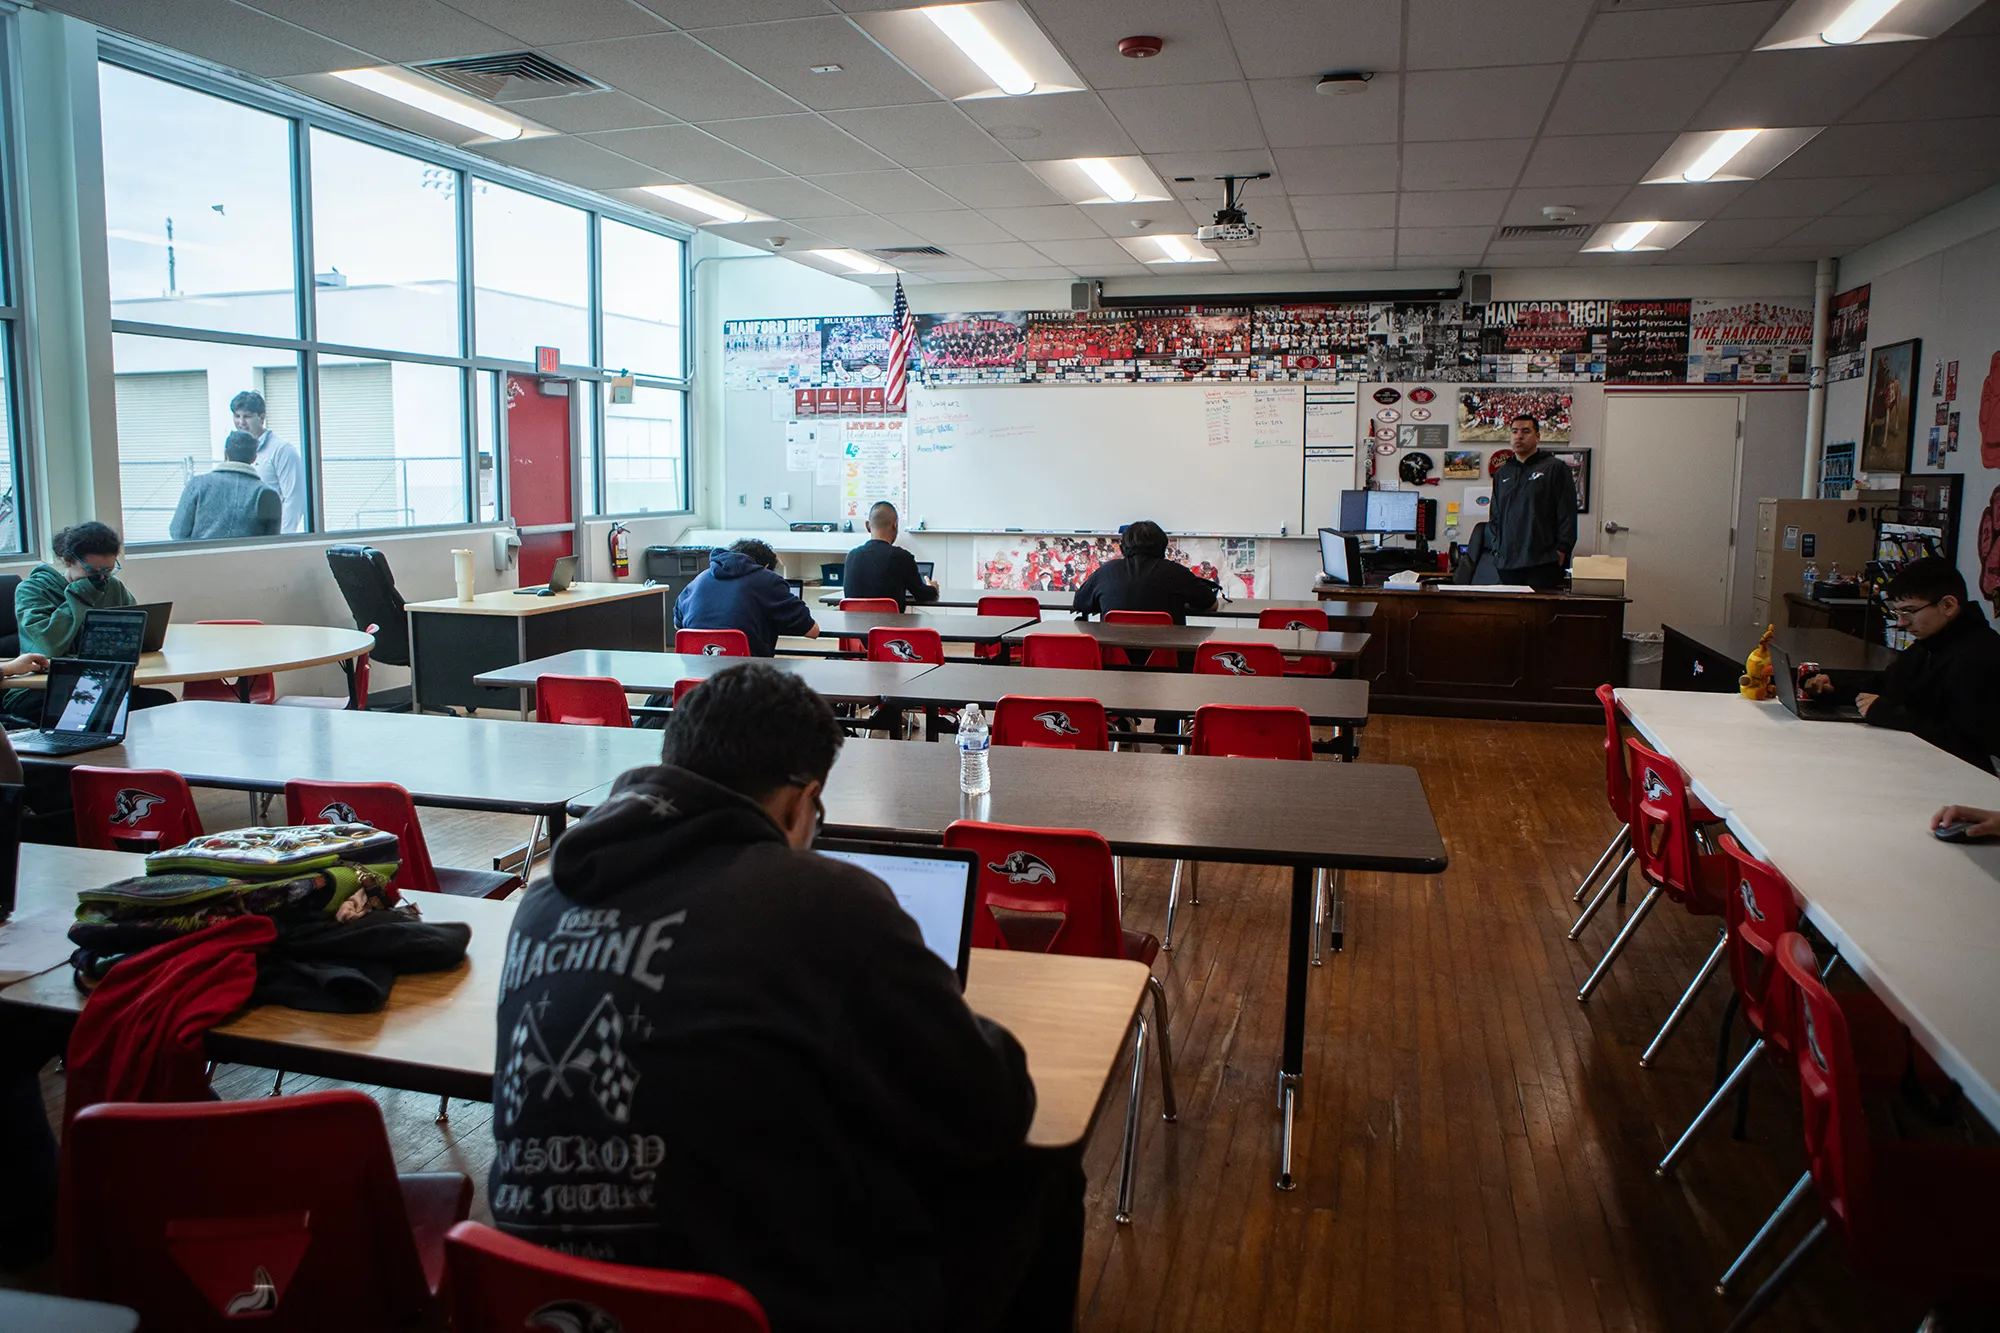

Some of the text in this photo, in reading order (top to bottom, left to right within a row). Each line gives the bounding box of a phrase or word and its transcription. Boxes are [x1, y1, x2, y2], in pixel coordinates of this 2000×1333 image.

[1086, 311, 1135, 320] FOOTBALL
[1568, 302, 1608, 324] HIGH
[932, 321, 1017, 337] BULLPUPS
[1693, 327, 1718, 339] THE
[1721, 327, 1783, 339] HANFORD
[541, 348, 558, 372] EXIT
[1059, 357, 1101, 366] SAY WIN
[846, 422, 903, 430] LEVELS OF
[552, 906, 621, 938] LOSER
[498, 909, 688, 1006] MACHINE
